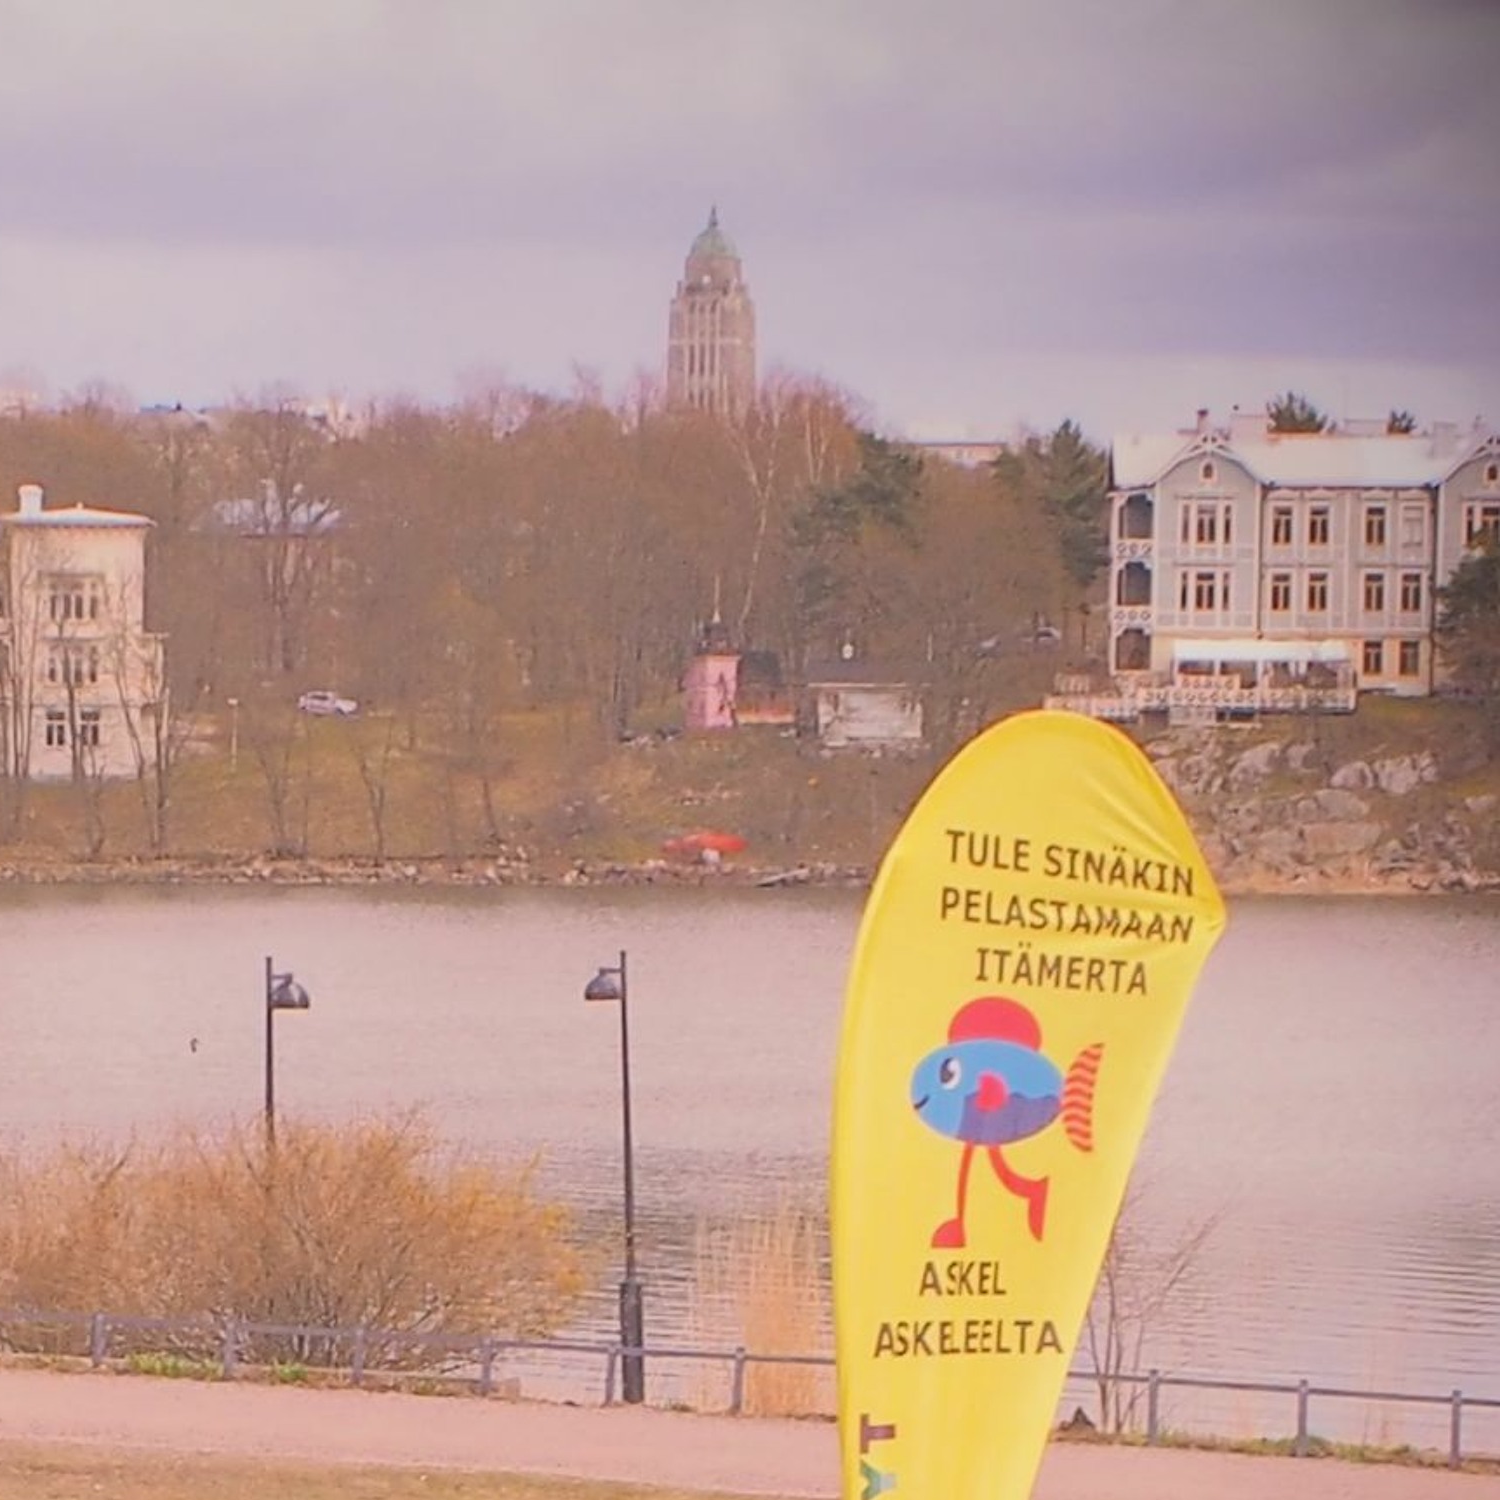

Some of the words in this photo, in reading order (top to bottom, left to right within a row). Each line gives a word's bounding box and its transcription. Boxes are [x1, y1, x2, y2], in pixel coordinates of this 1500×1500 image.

[946, 829, 1031, 873] TULE
[1043, 845, 1194, 897] SINÄKIN
[940, 886, 1194, 943] PELASTAMAAN
[975, 941, 1147, 995] ITÄMERTA
[919, 1261, 1007, 1296] ASKEL
